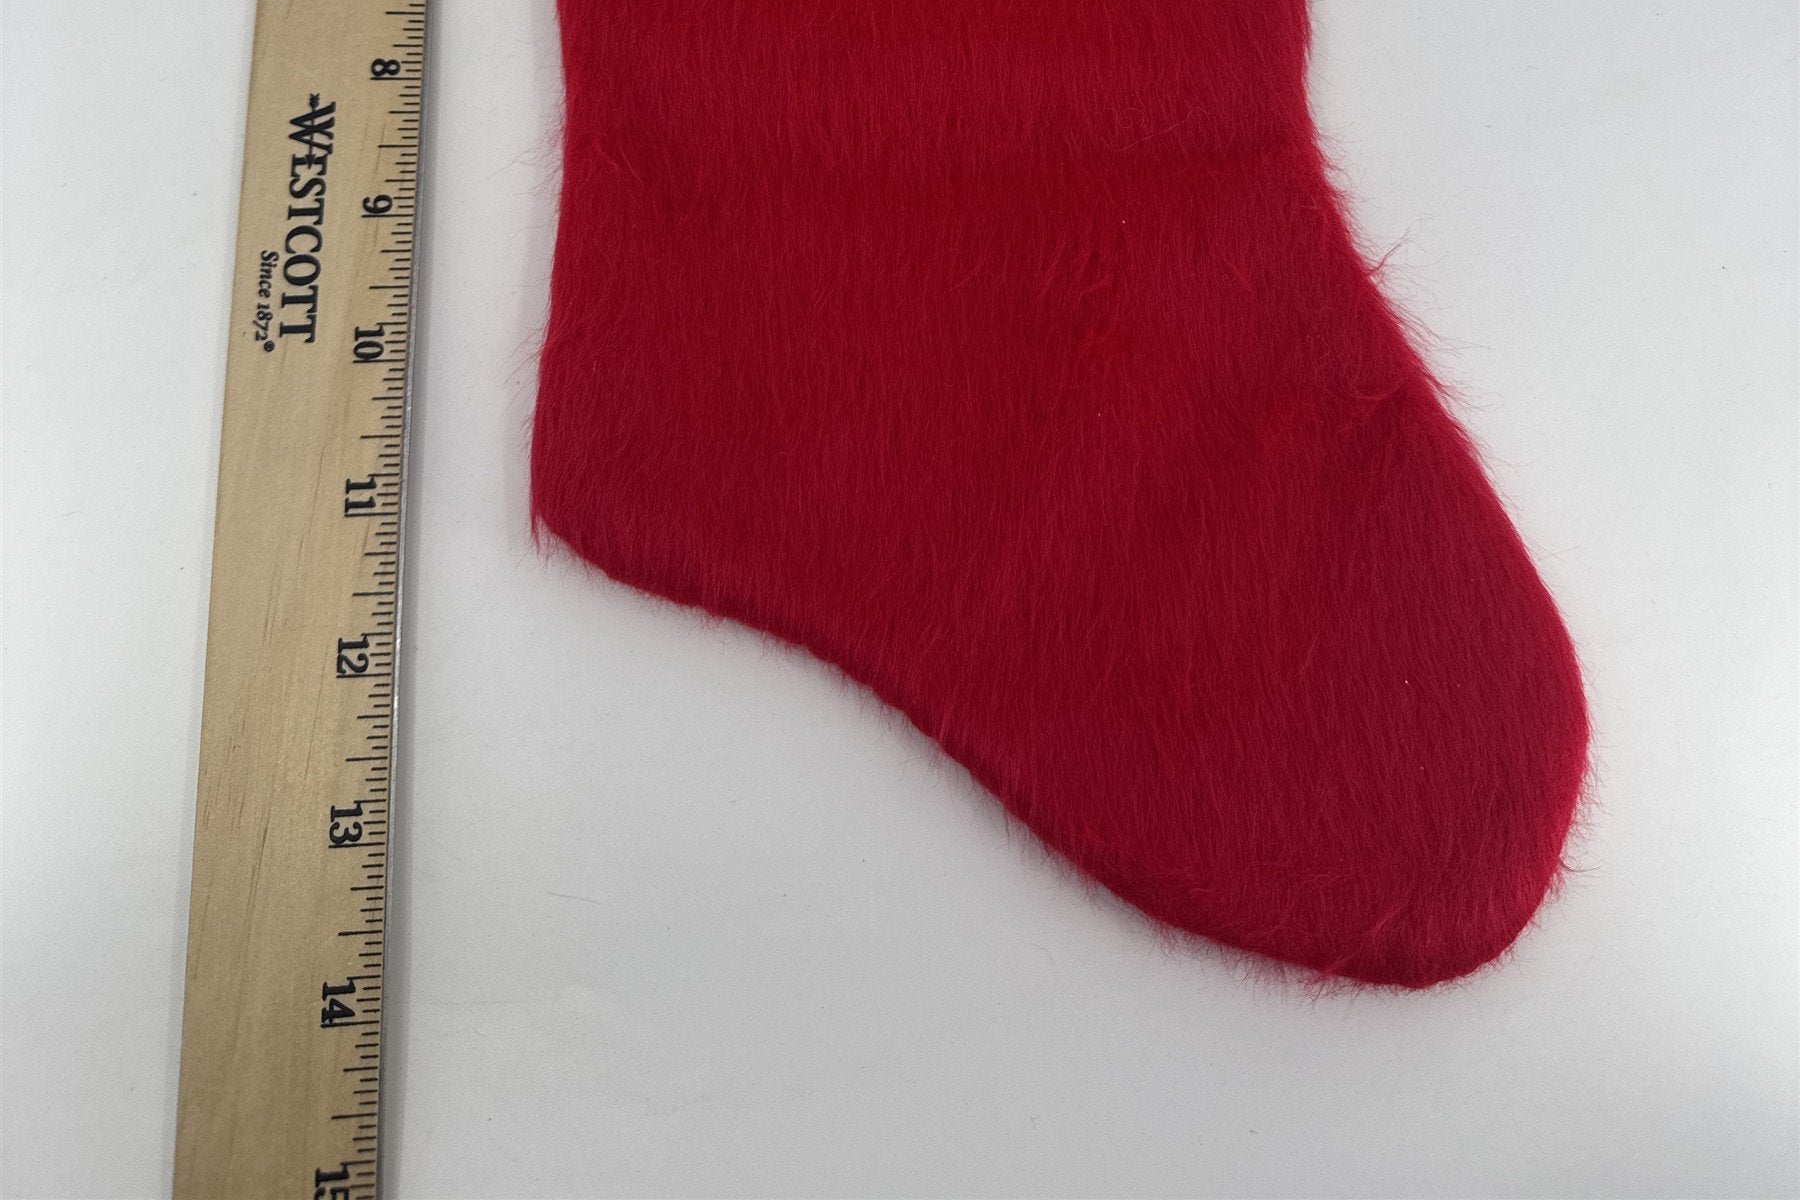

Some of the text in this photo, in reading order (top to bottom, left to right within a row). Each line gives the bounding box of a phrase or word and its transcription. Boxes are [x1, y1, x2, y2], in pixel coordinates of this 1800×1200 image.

[371, 58, 401, 78] 8
[279, 100, 337, 343] WESTCOTT
[362, 194, 393, 214] 9
[252, 250, 280, 342] Since 1872
[353, 326, 385, 360] 10
[344, 477, 377, 513] 11
[336, 635, 370, 674] 12
[328, 804, 363, 846] 13
[321, 982, 356, 1025] 14
